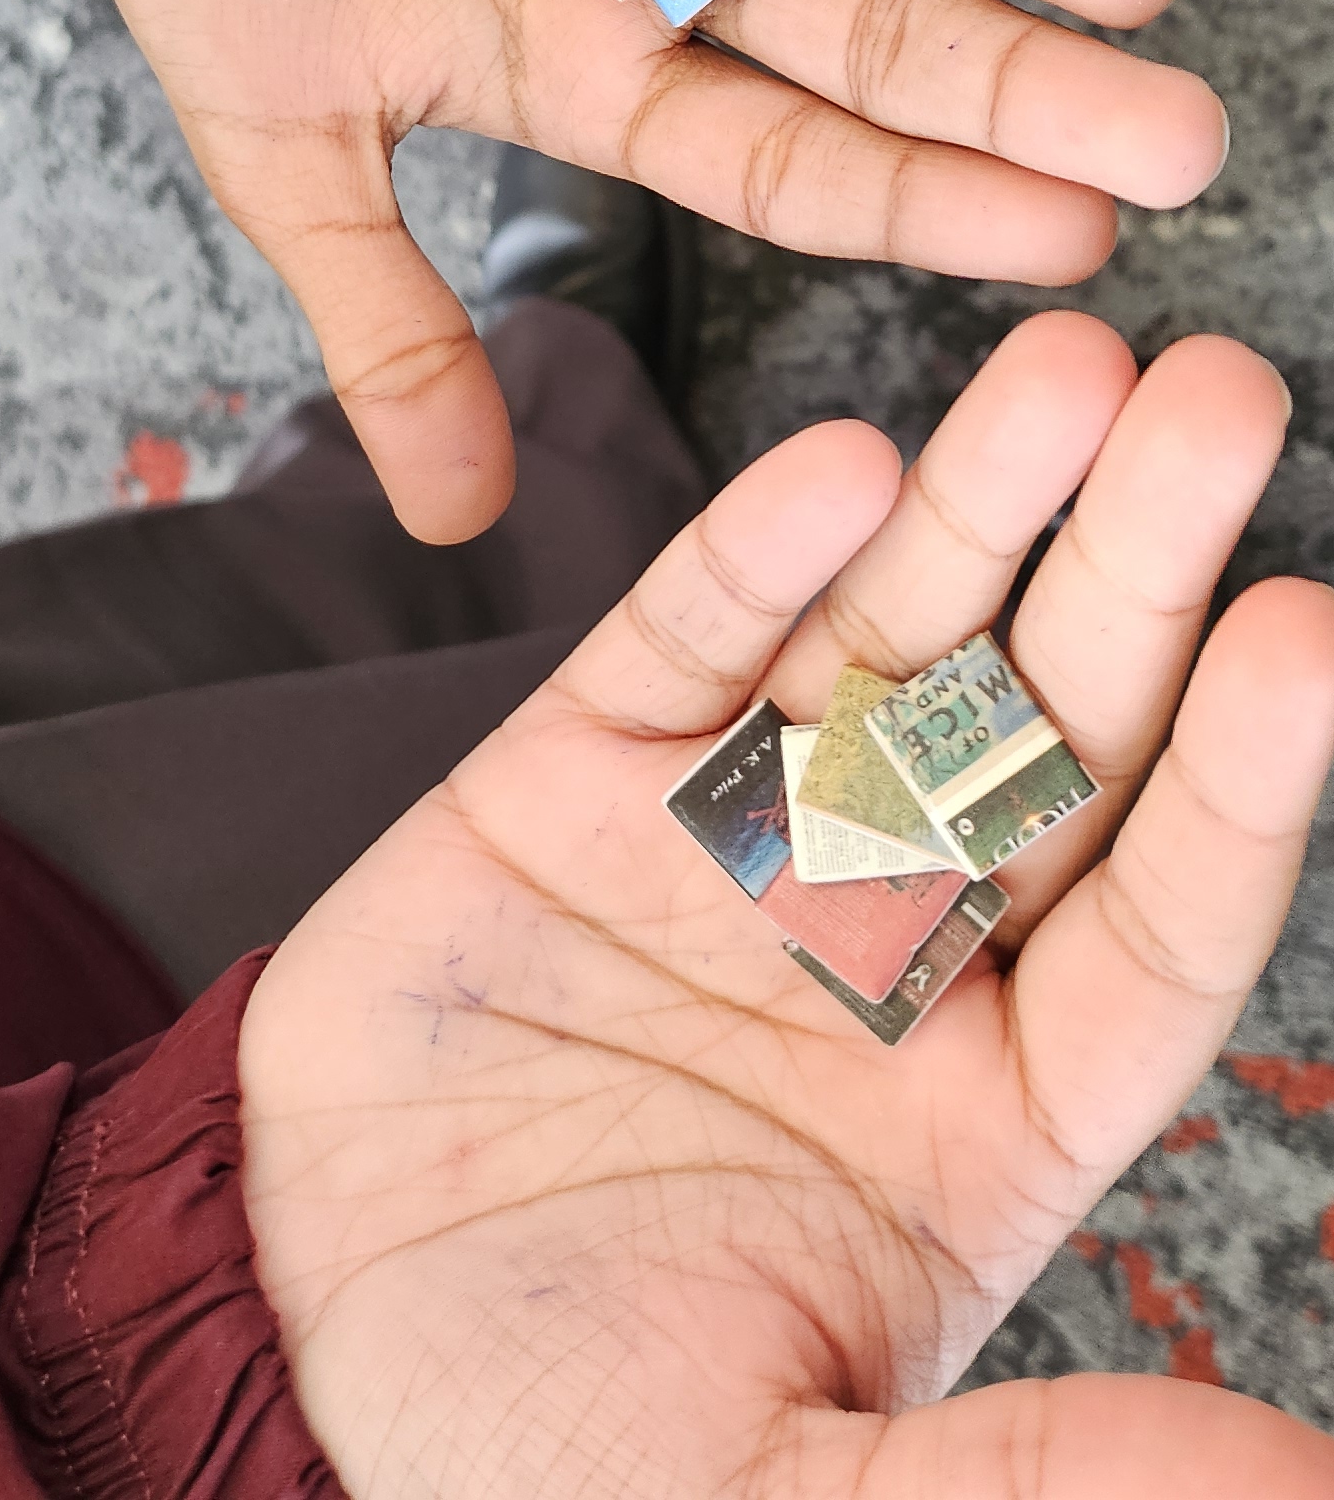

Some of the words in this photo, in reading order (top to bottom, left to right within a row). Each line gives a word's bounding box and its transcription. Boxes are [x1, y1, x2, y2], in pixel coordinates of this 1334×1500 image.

[917, 669, 963, 709] AND
[906, 664, 1015, 762] MICE
[962, 726, 990, 754] OF
